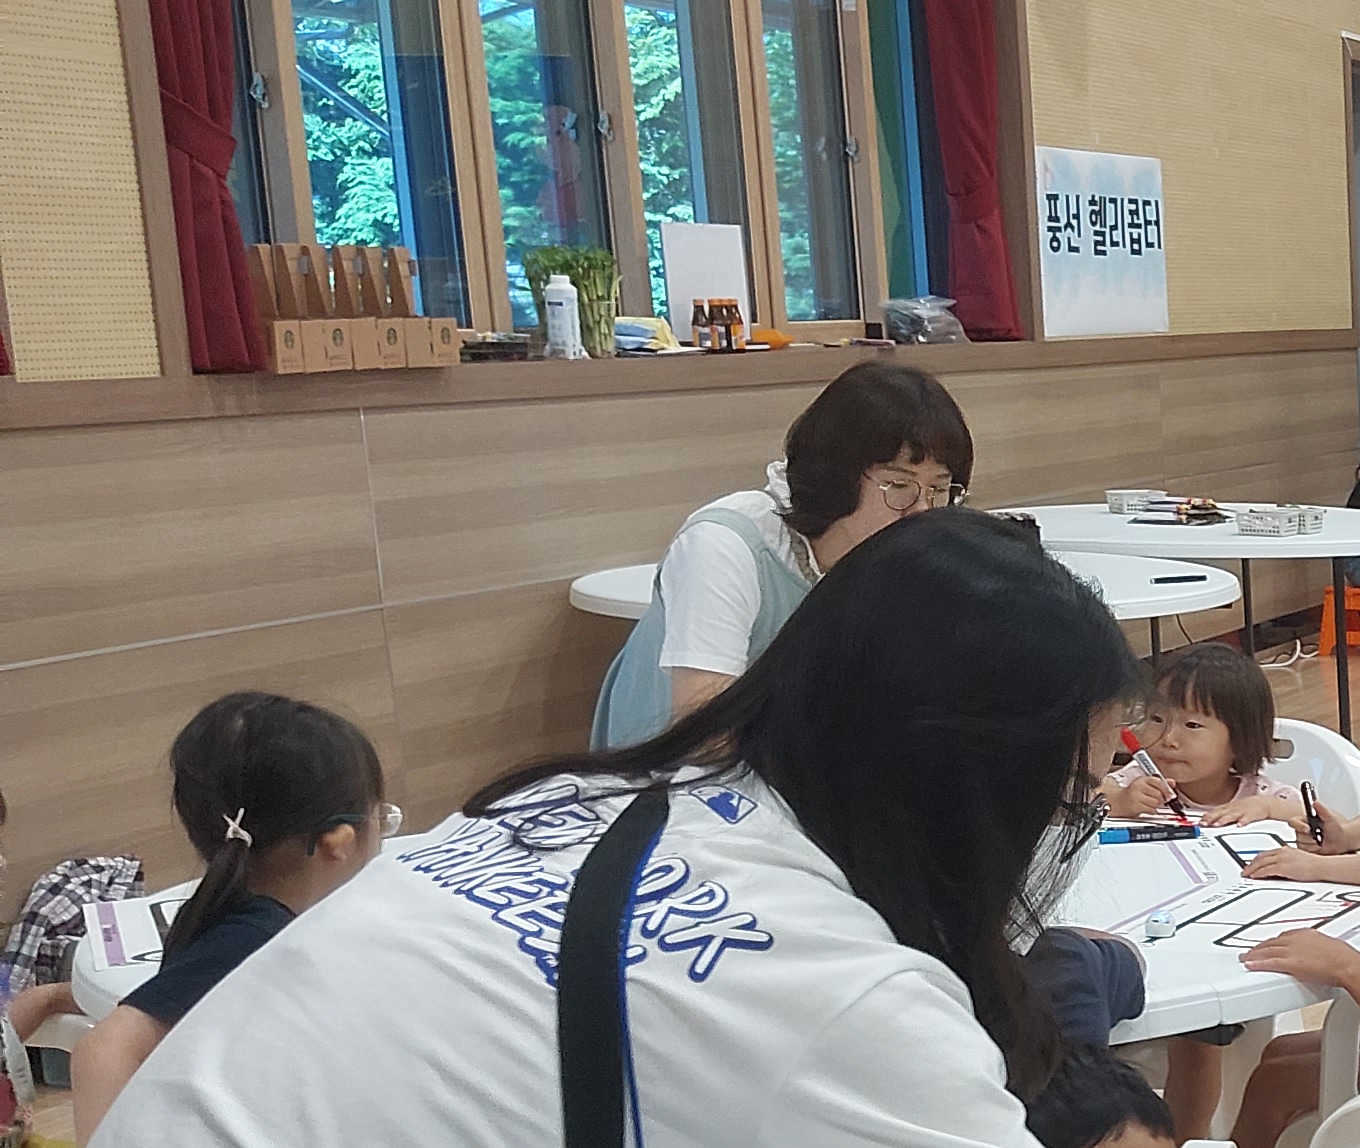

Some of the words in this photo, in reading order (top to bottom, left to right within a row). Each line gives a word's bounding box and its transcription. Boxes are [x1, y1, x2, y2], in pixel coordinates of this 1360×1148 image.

[1045, 193, 1081, 254] 풍선
[1087, 193, 1163, 257] 헬리콥터
[630, 854, 774, 984] ORK
